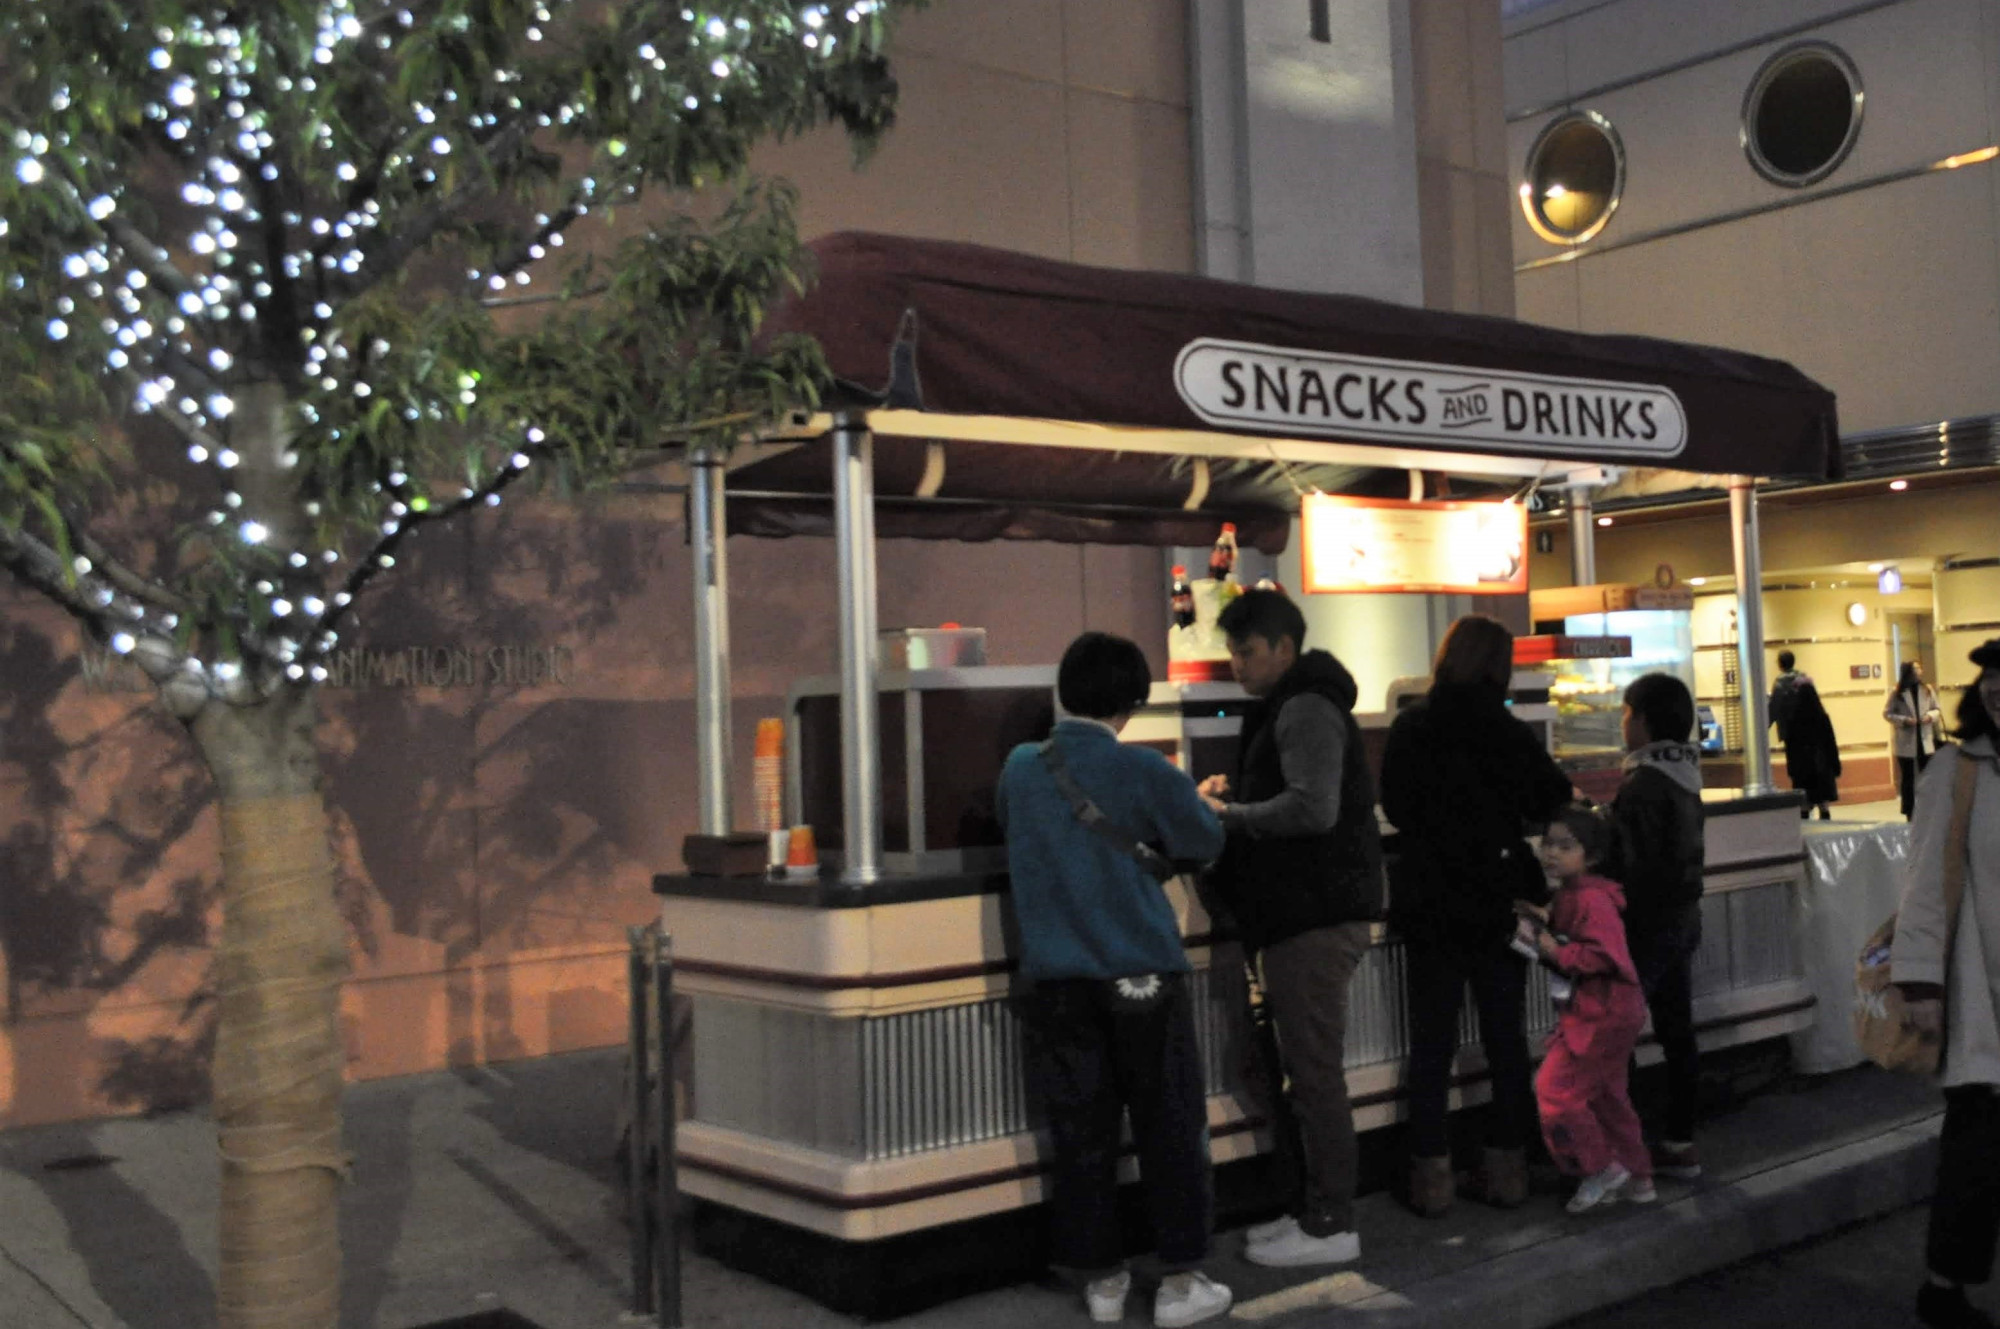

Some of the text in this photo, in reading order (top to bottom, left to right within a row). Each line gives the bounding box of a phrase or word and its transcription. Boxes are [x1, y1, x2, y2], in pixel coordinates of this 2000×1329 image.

[1221, 360, 1658, 440] SNACKS AND DRINKS
